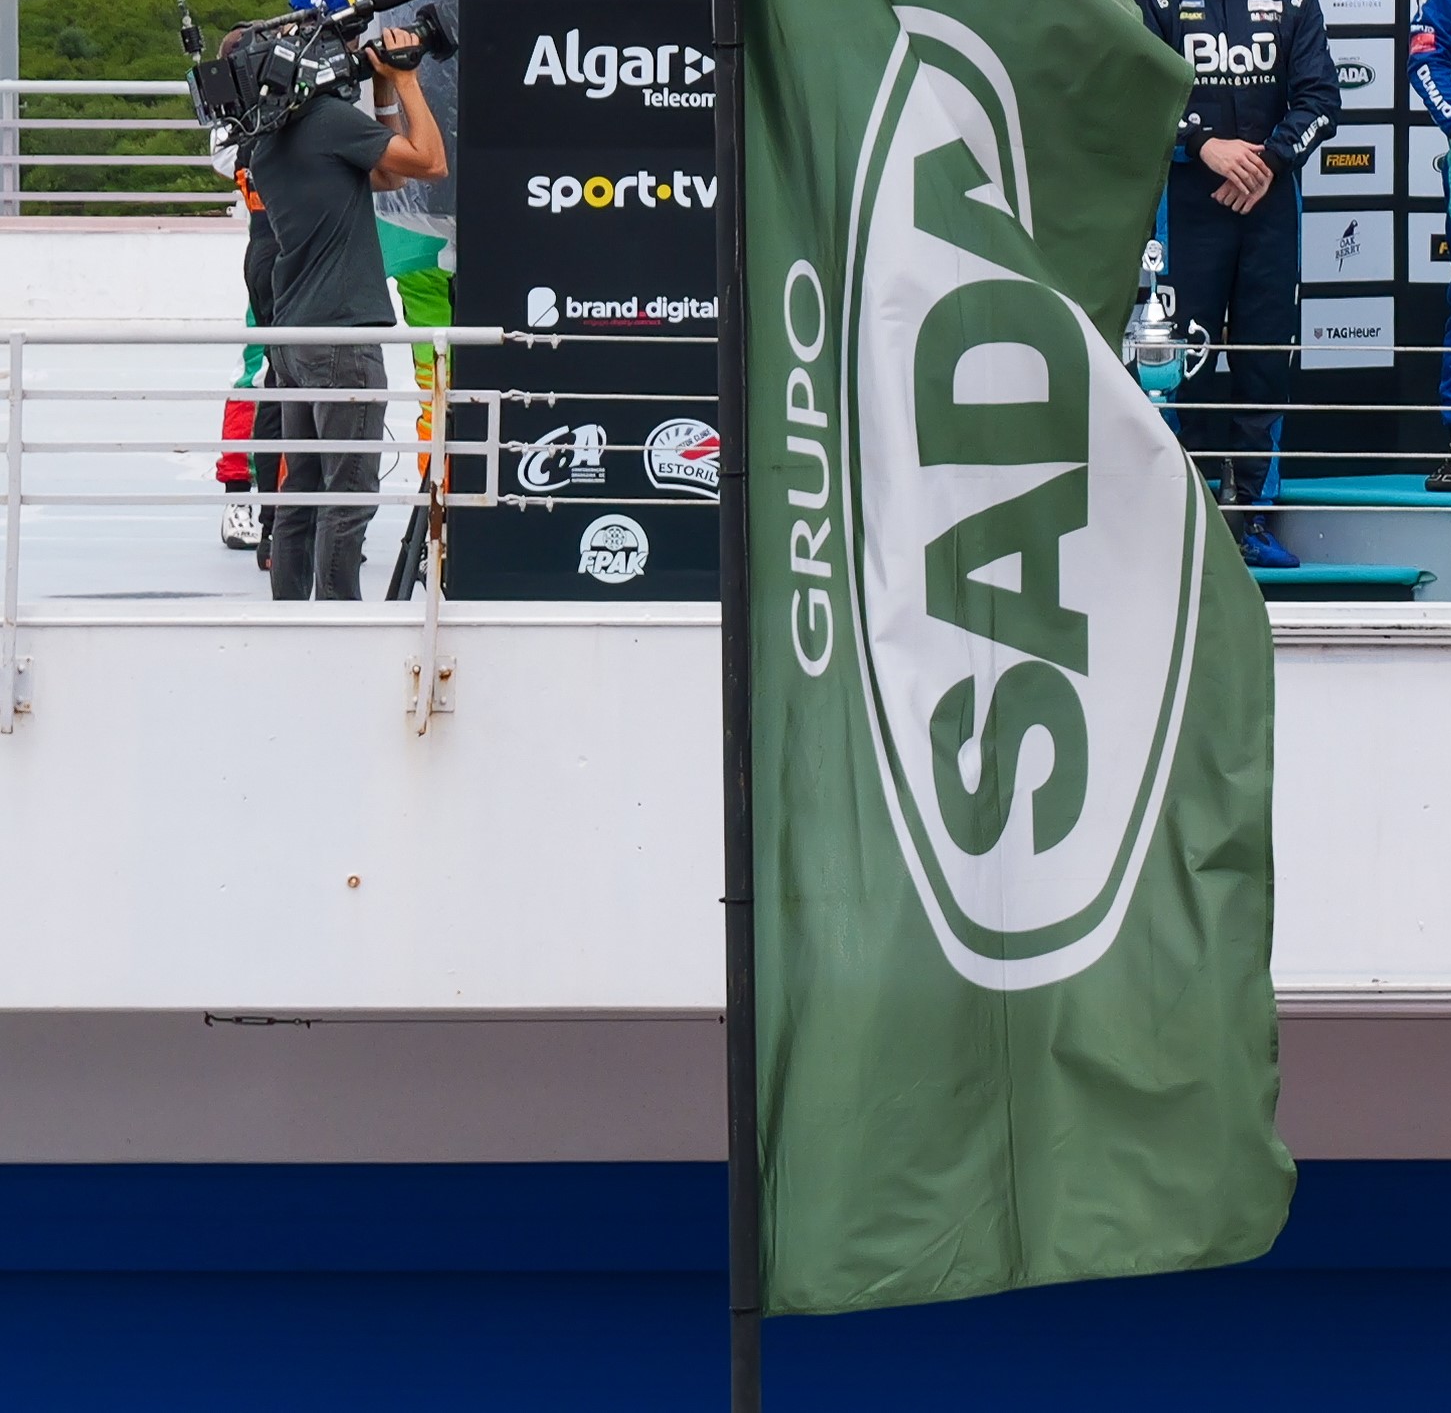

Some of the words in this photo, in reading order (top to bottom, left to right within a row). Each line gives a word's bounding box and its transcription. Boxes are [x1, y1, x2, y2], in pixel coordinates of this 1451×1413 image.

[524, 29, 679, 99] Algar
[1327, 154, 1369, 166] FREMAX
[659, 463, 716, 483] ESTORIL
[783, 259, 835, 679] GRUPO
[914, 138, 1091, 857] SADA
